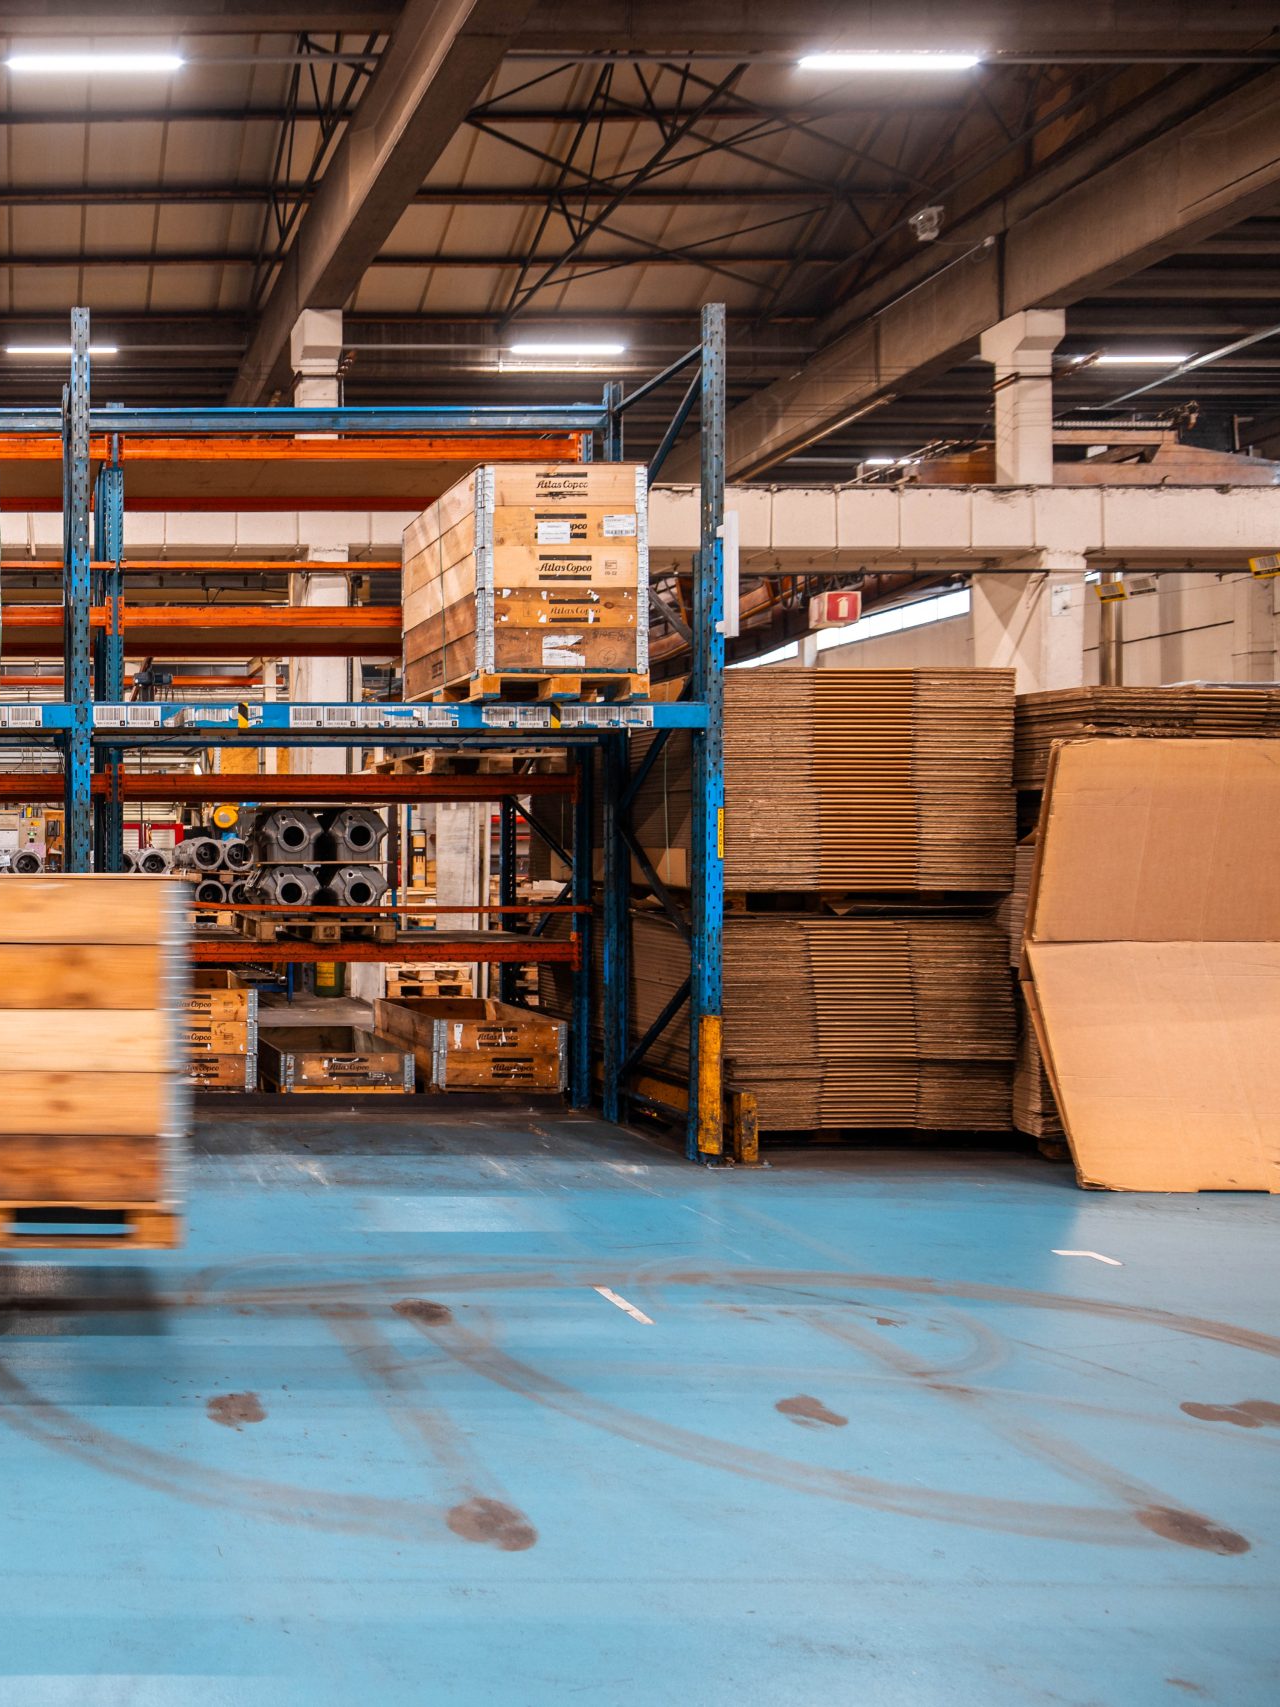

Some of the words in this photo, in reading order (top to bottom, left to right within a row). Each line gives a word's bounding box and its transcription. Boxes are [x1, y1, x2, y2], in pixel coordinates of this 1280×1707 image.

[536, 480, 562, 489] Atlas
[563, 480, 588, 491] Copco
[570, 522, 588, 532] pco
[540, 562, 565, 572] Atlas
[566, 562, 592, 574] Copco
[550, 606, 576, 615] Atlas
[191, 1000, 212, 1009] Copco
[191, 1033, 212, 1042] Copco
